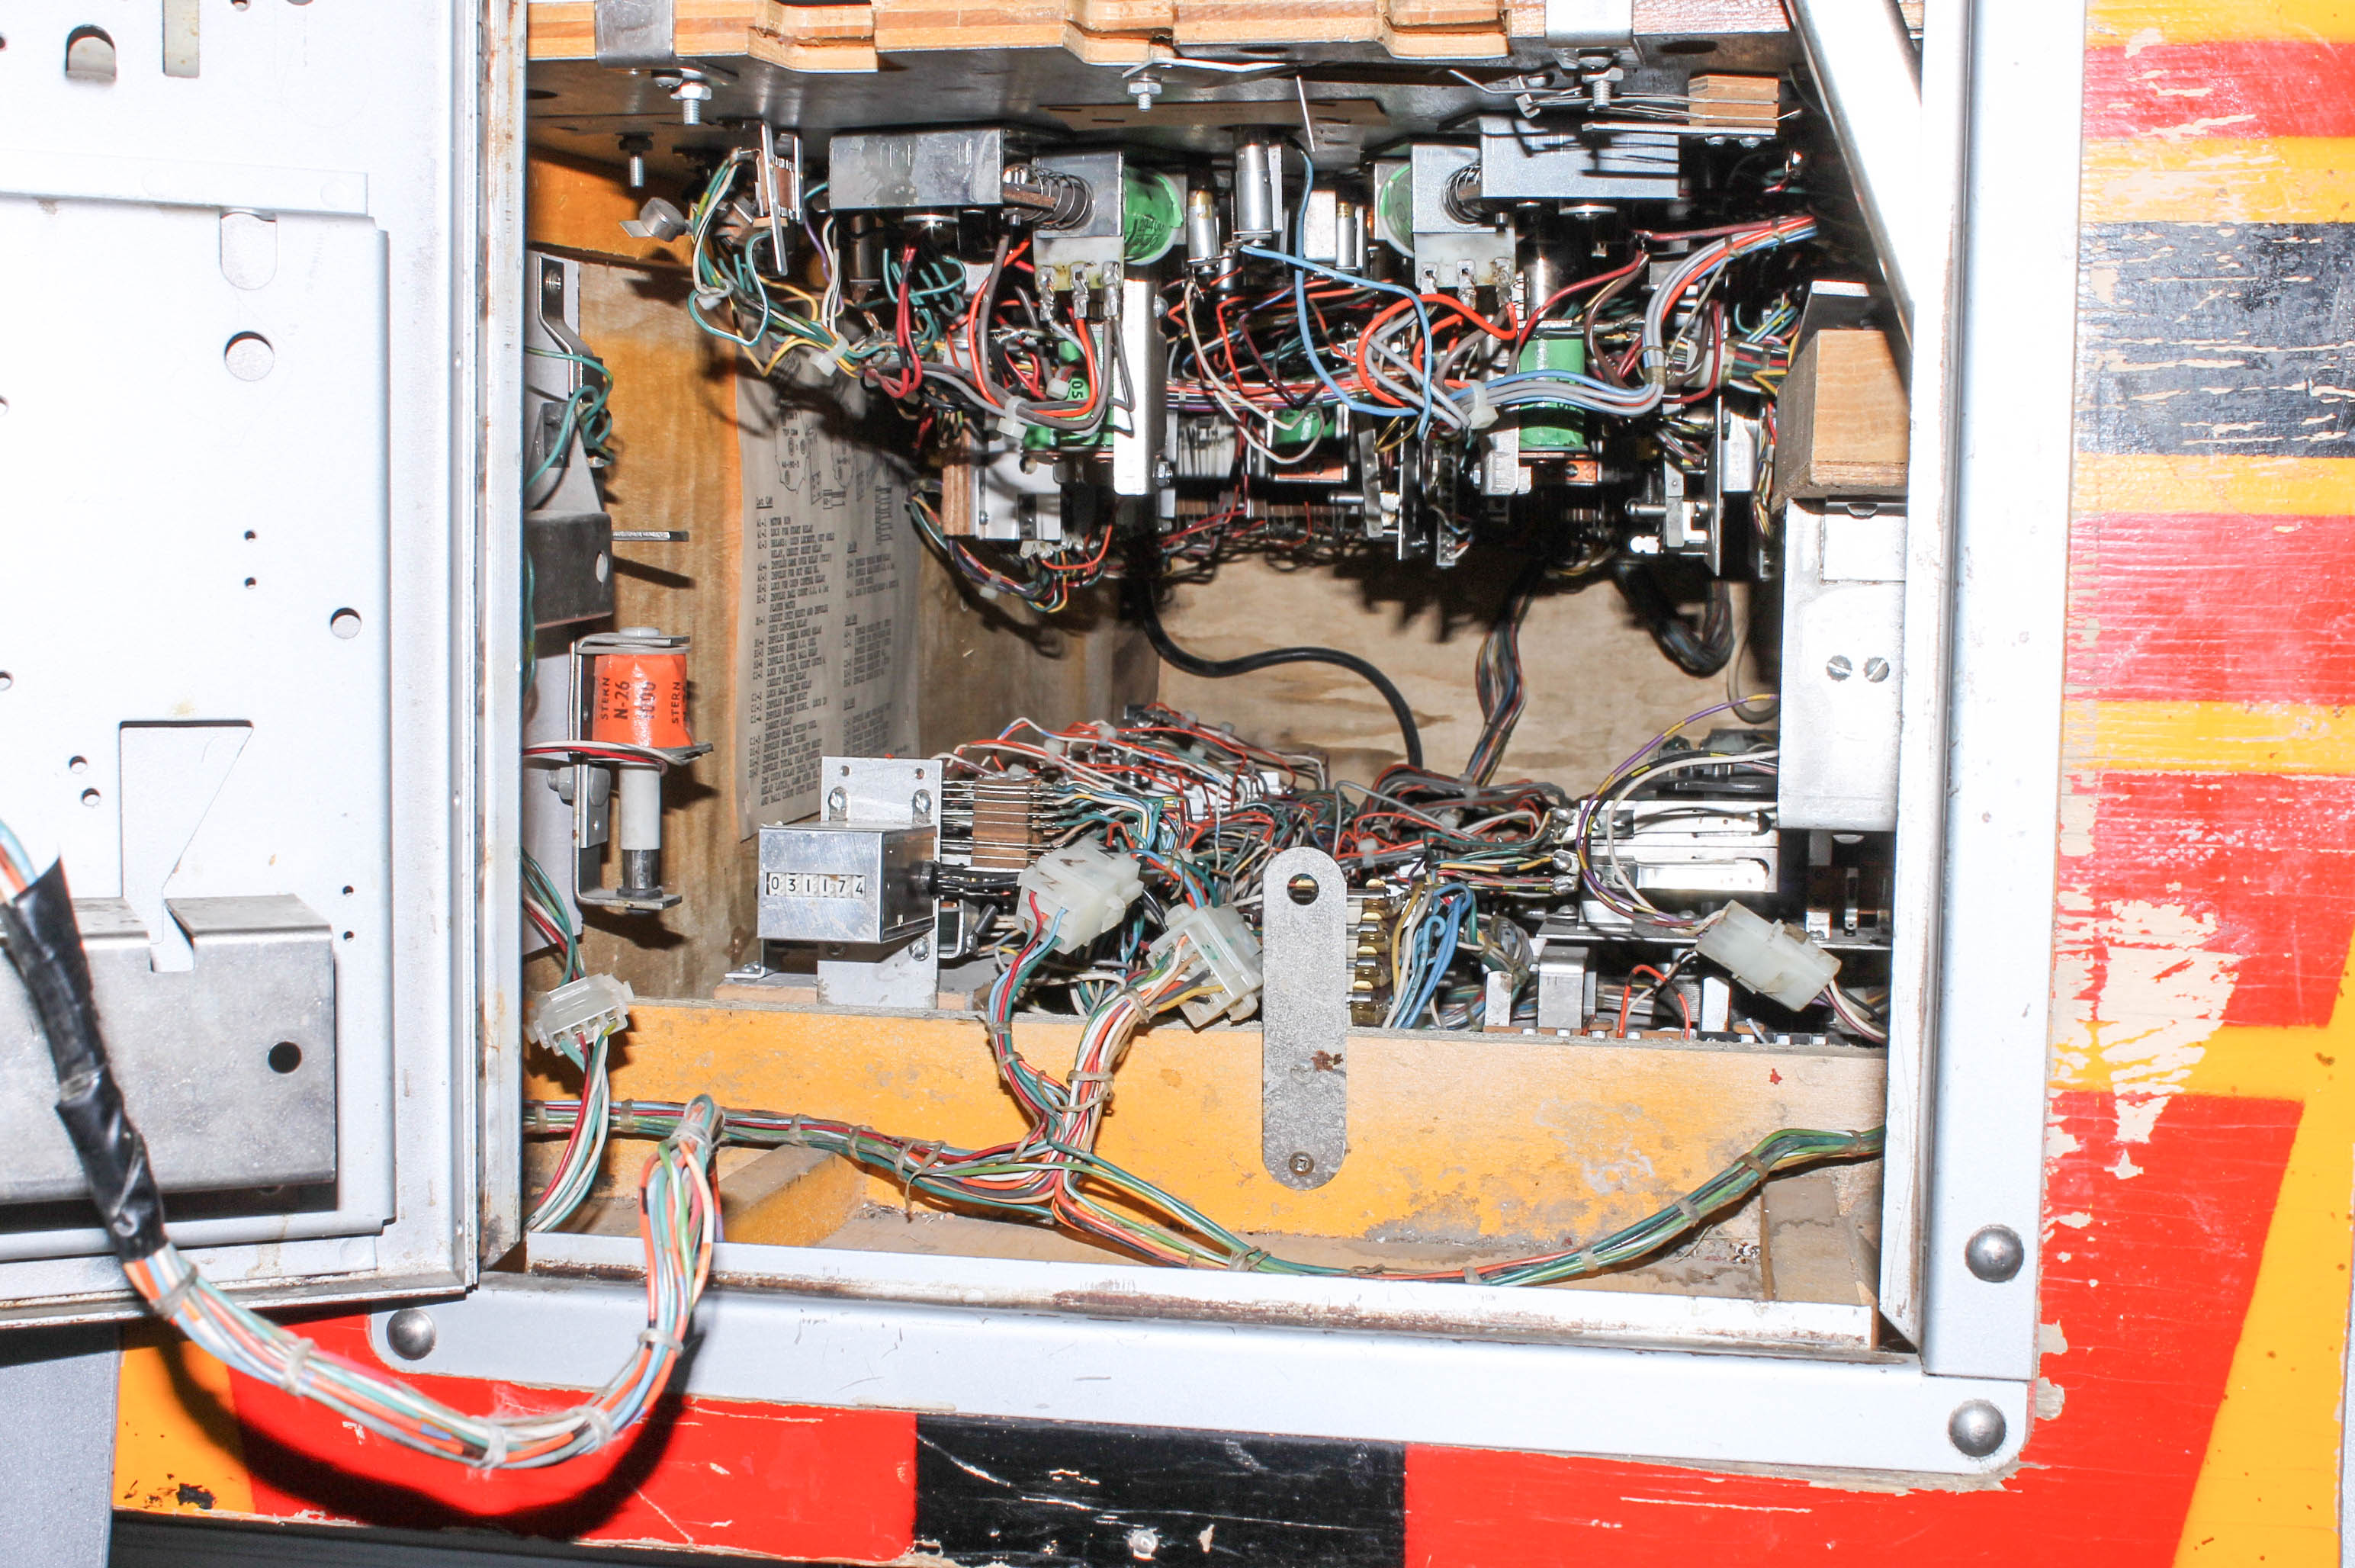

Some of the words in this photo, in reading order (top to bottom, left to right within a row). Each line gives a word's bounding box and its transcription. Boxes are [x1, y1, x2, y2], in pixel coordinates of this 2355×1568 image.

[600, 676, 611, 720] STERN
[614, 680, 630, 720] N-26
[671, 681, 681, 725] STERN
[771, 876, 863, 895] 031174
